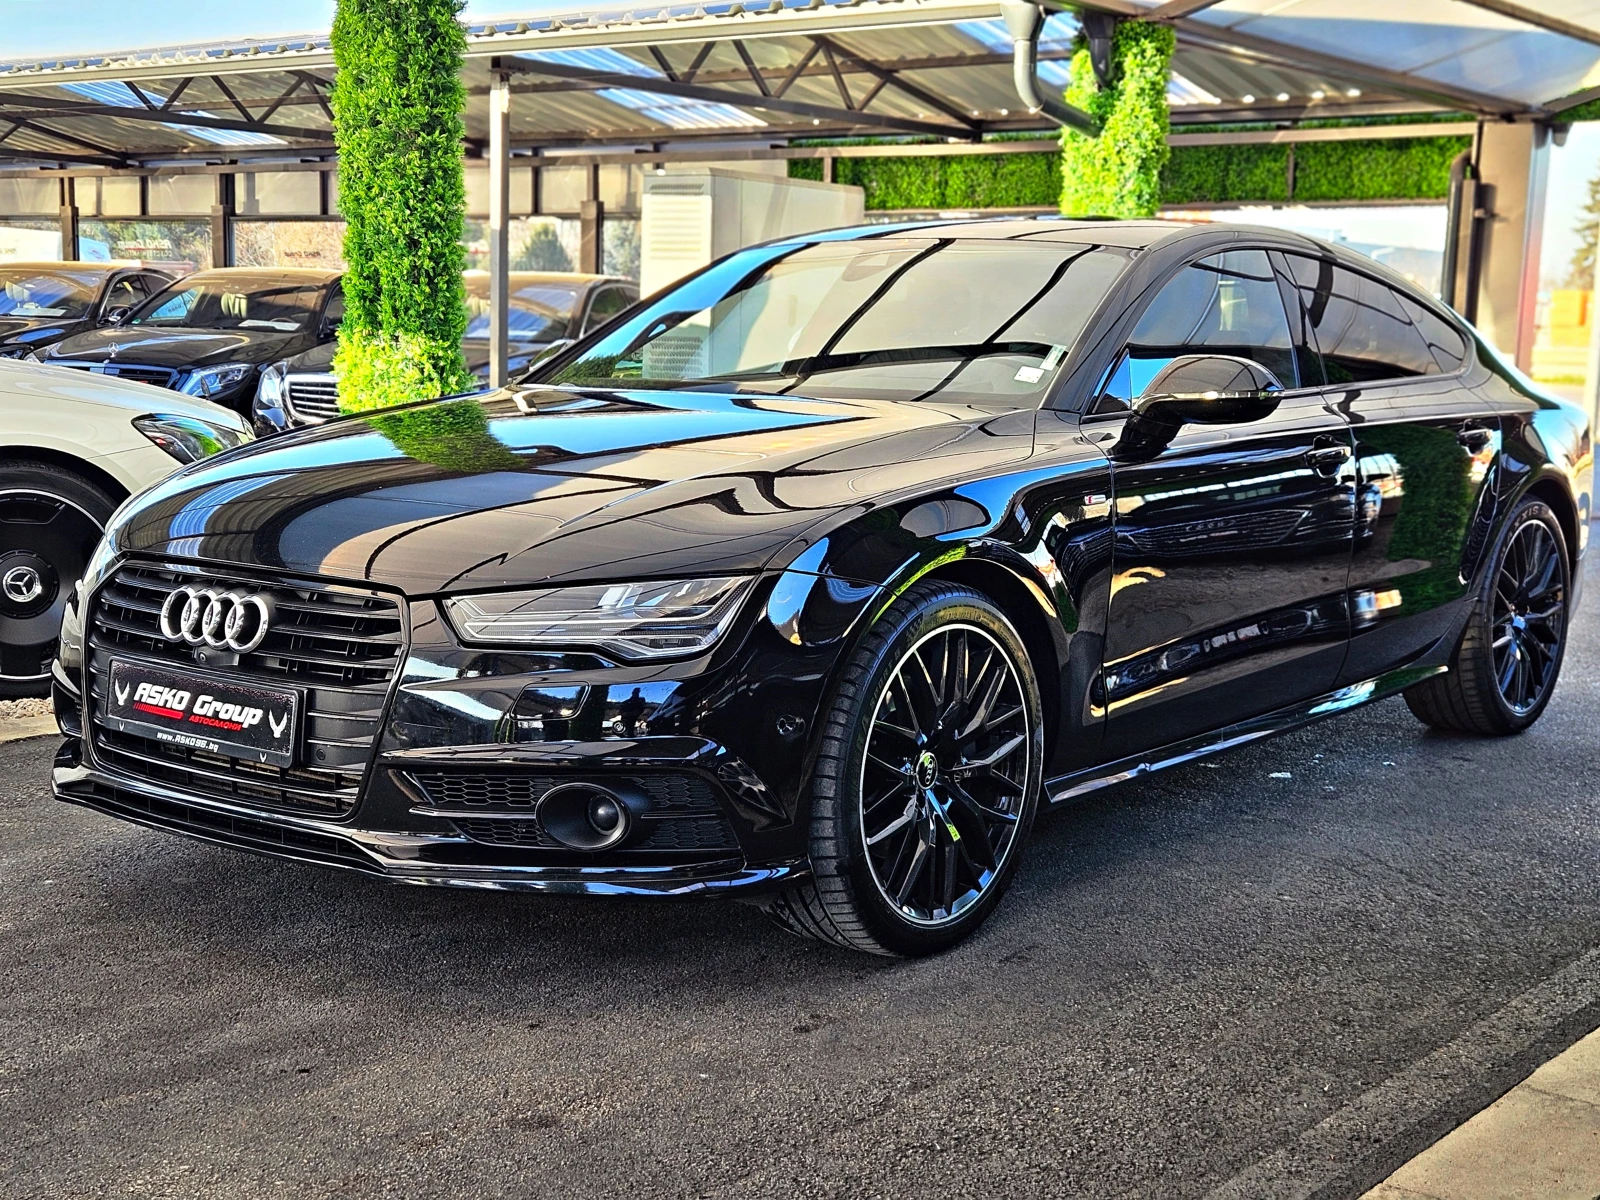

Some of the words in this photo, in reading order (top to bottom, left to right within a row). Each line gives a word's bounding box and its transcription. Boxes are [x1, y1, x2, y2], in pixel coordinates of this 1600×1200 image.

[133, 682, 191, 712] ASKO
[193, 694, 264, 728] Group
[188, 715, 242, 731] АВТОСАЛОНИ
